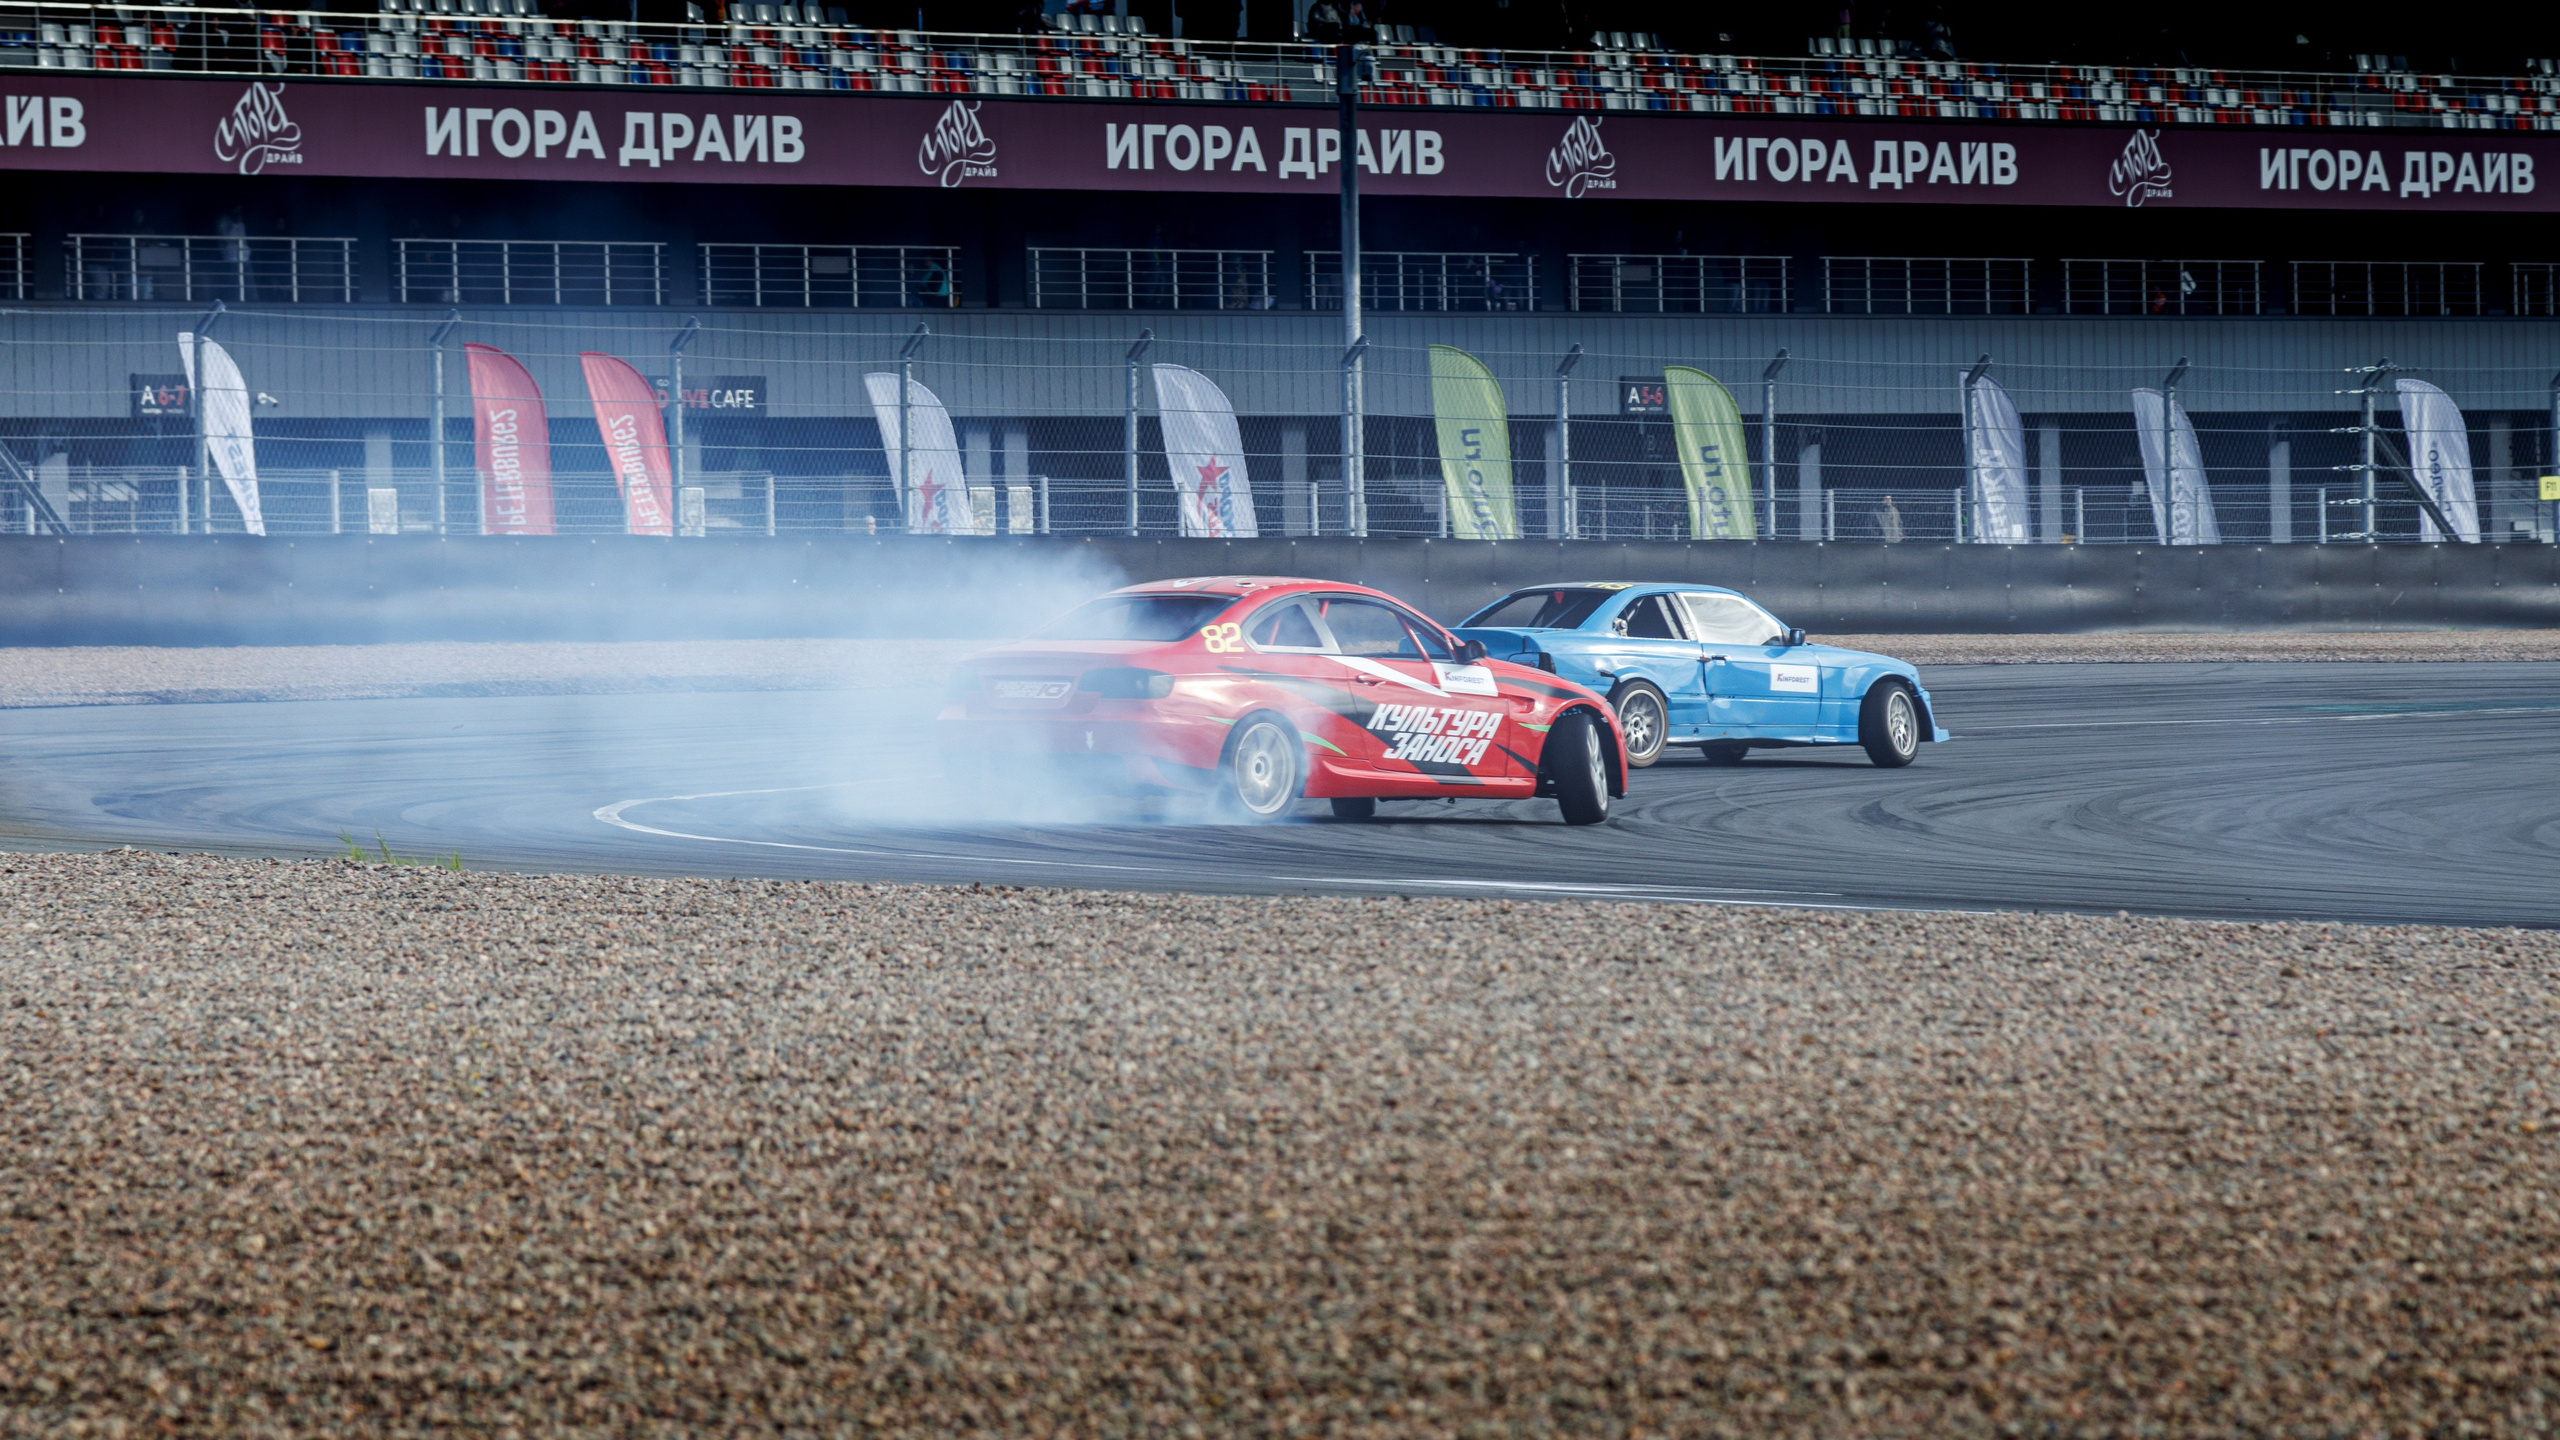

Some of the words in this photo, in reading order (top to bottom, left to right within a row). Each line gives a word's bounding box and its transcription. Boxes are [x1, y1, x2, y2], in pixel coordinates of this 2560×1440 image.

[0, 95, 86, 148] ЙВ
[425, 106, 607, 160] ИГОРА
[618, 111, 805, 168] ДРАЙВ
[265, 151, 303, 164] ДРАЙВ
[1106, 122, 1268, 172] ИГОРА
[1278, 127, 1445, 180] ДРАЙВ
[1714, 136, 1859, 183] ИГОРА
[1869, 140, 2018, 190] ДРАЙВ
[2261, 148, 2392, 192] ИГОРА
[2400, 151, 2536, 198] ДРАЙВ
[158, 385, 186, 406] 6-7
[656, 388, 709, 409] DIVE
[710, 388, 755, 409] CAFE
[1641, 386, 1664, 405] 5-6
[1199, 622, 1246, 654] 82
[1366, 703, 1504, 739] КУЛЬТУРА
[1382, 732, 1492, 766] ЗАНОСА
